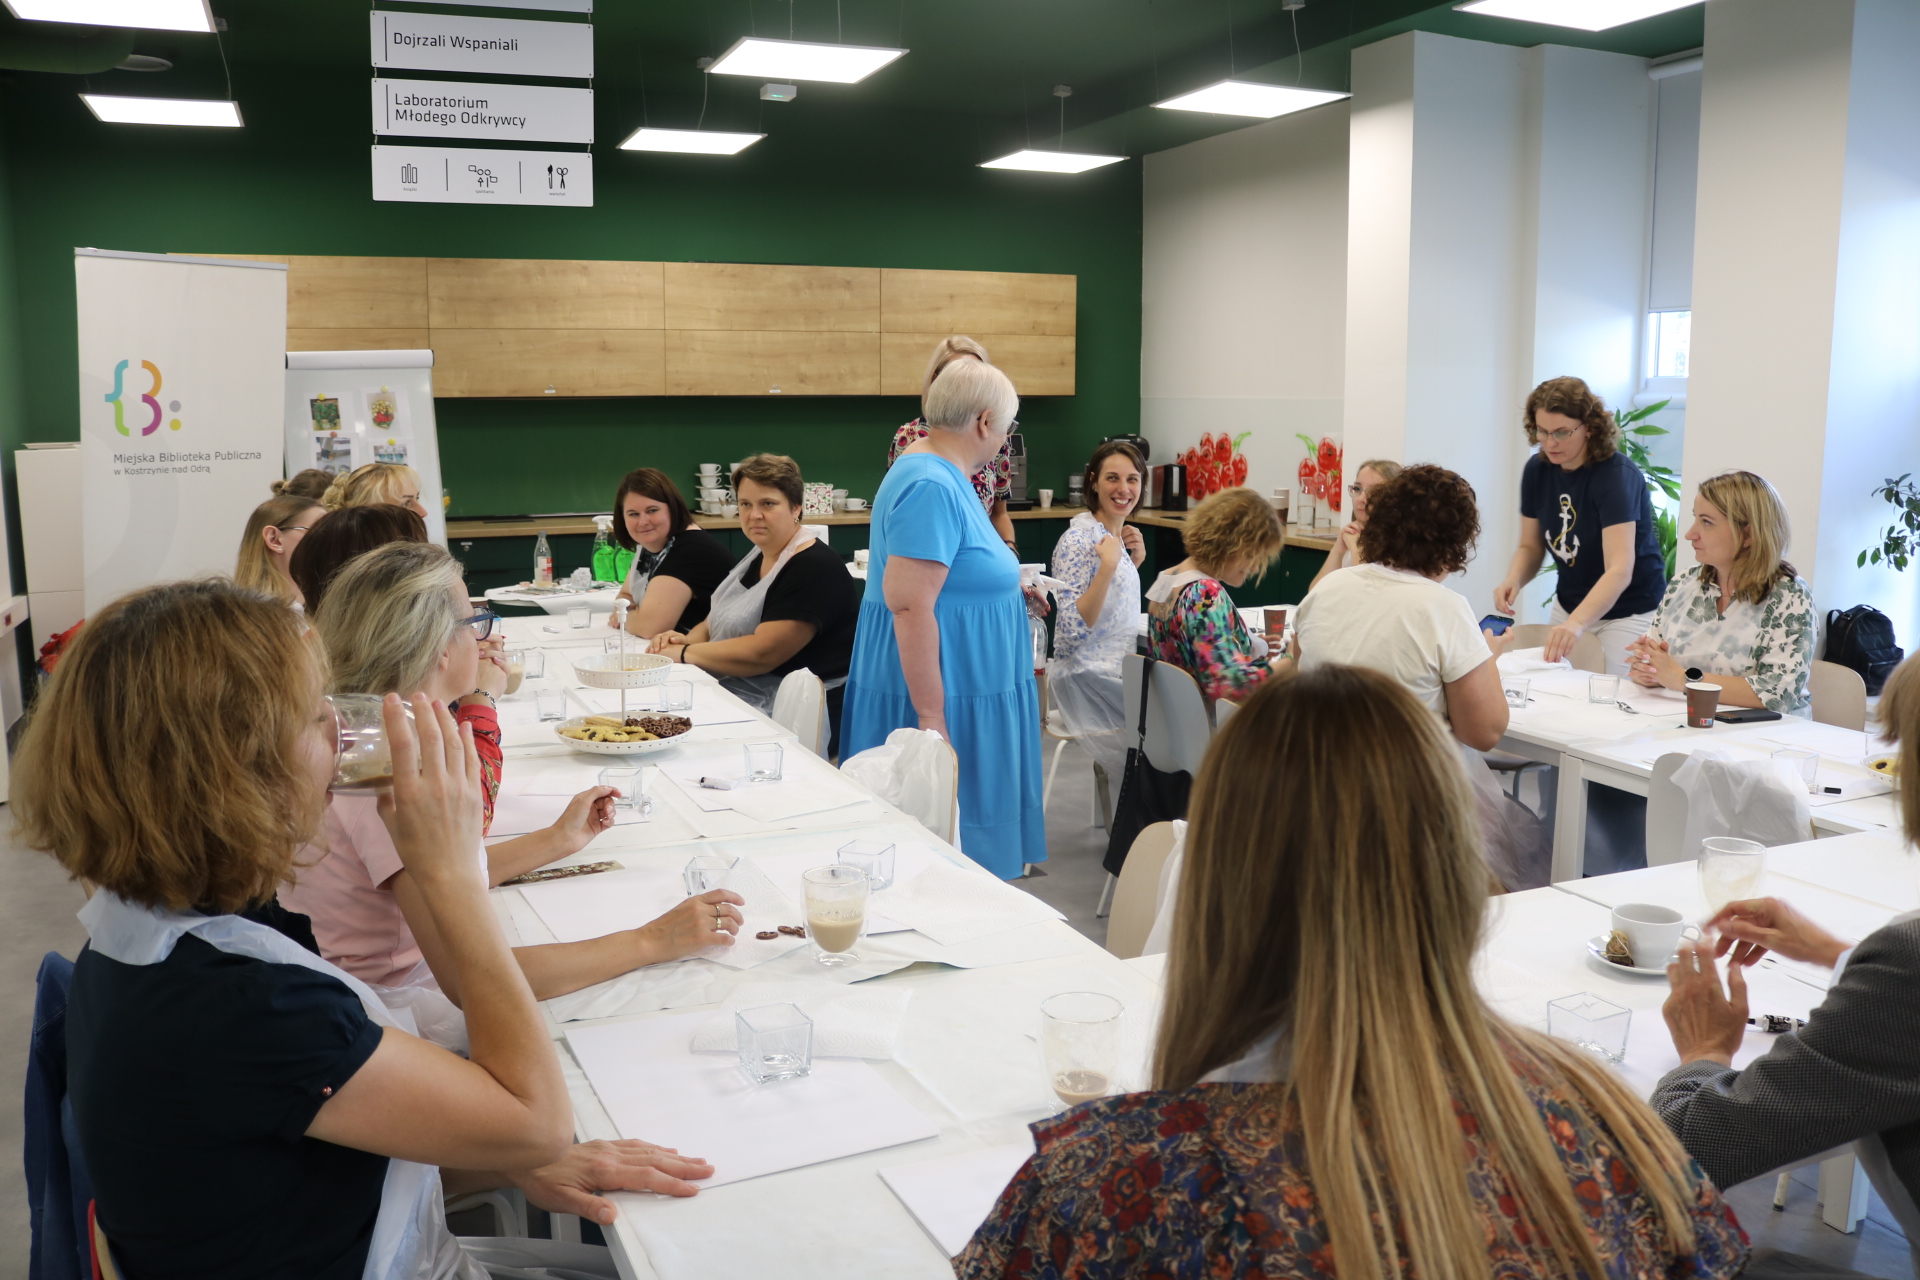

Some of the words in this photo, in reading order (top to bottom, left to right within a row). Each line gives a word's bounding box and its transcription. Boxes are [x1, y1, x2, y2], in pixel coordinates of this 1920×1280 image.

[394, 32, 446, 48] Dojrzali
[450, 36, 518, 52] Wspaniali
[395, 93, 488, 109] Laboratorium
[395, 109, 456, 126] Młodego
[461, 111, 526, 129] Odkrywcy
[113, 453, 155, 466] Miejska
[159, 451, 211, 463] Biblioteka
[214, 450, 262, 461] Publiczna
[113, 468, 122, 476] w
[124, 466, 170, 476] Kostrzynie
[172, 465, 188, 474] nad
[190, 465, 212, 474] Odrą
